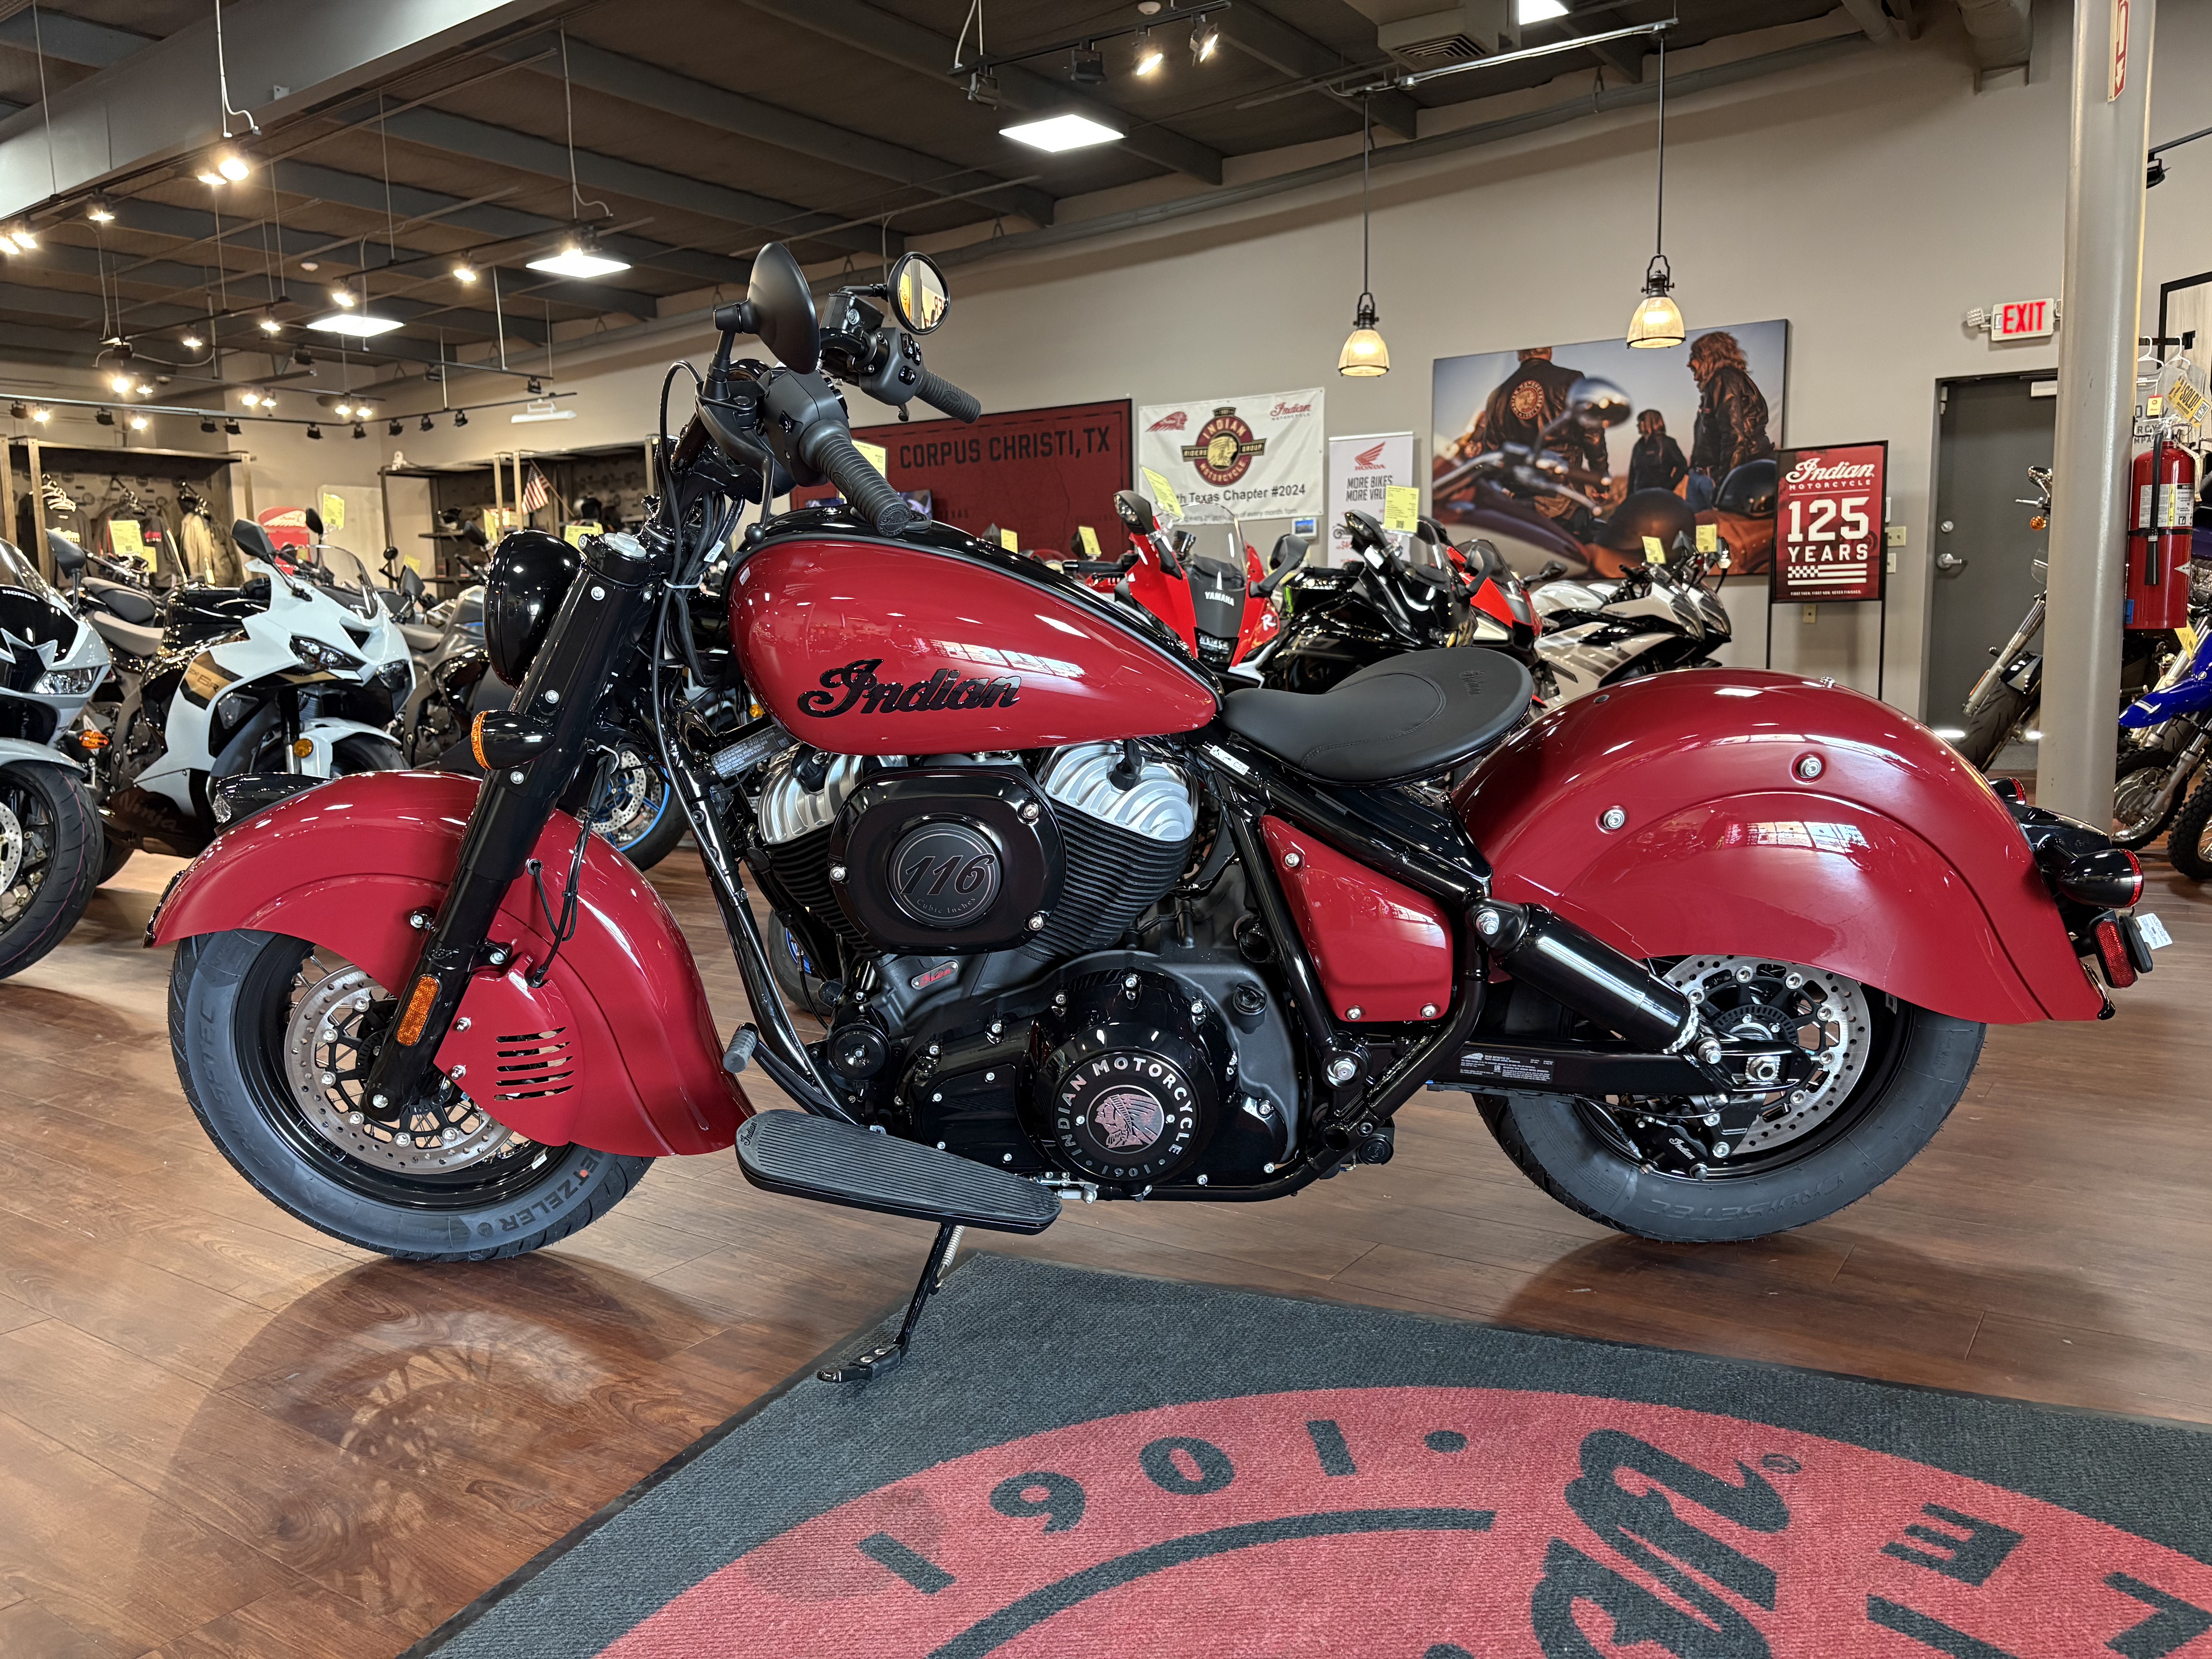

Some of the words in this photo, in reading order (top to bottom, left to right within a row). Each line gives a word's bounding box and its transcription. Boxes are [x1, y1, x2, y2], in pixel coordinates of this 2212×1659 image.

[2002, 301, 2046, 334] EXIT
[2179, 385, 2202, 411] SOLD!
[1269, 402, 1311, 417] Indian
[1202, 418, 1246, 439] INDIAN
[900, 438, 981, 469] CORPUS
[1199, 460, 1245, 483] MOTORCYCLE
[1785, 457, 1875, 483] Indian
[1347, 477, 1369, 489] MORE
[1370, 475, 1393, 488] BIKES
[1789, 479, 1871, 491] MOTORCYCLE
[1190, 493, 1219, 503] Texas
[1223, 488, 1267, 503] Chapter
[1271, 484, 1305, 497] #2024
[1346, 489, 1368, 501] MORE
[1788, 496, 1870, 543] 125
[1788, 544, 1868, 563] YEARS
[2, 589, 38, 602] HONDA
[1204, 591, 1235, 606] YAMAHA
[797, 658, 1022, 718] Indian
[900, 853, 996, 895] 116
[917, 898, 942, 914] Cubic
[947, 897, 976, 914] Inches
[1058, 1074, 1087, 1156] INDIAN
[1092, 1056, 1193, 1155] MOTORCYCLE
[740, 1122, 758, 1146] Indian
[1668, 1138, 1695, 1160] Indian
[1101, 1164, 1151, 1178] 1901
[858, 1419, 1356, 1594] 1901
